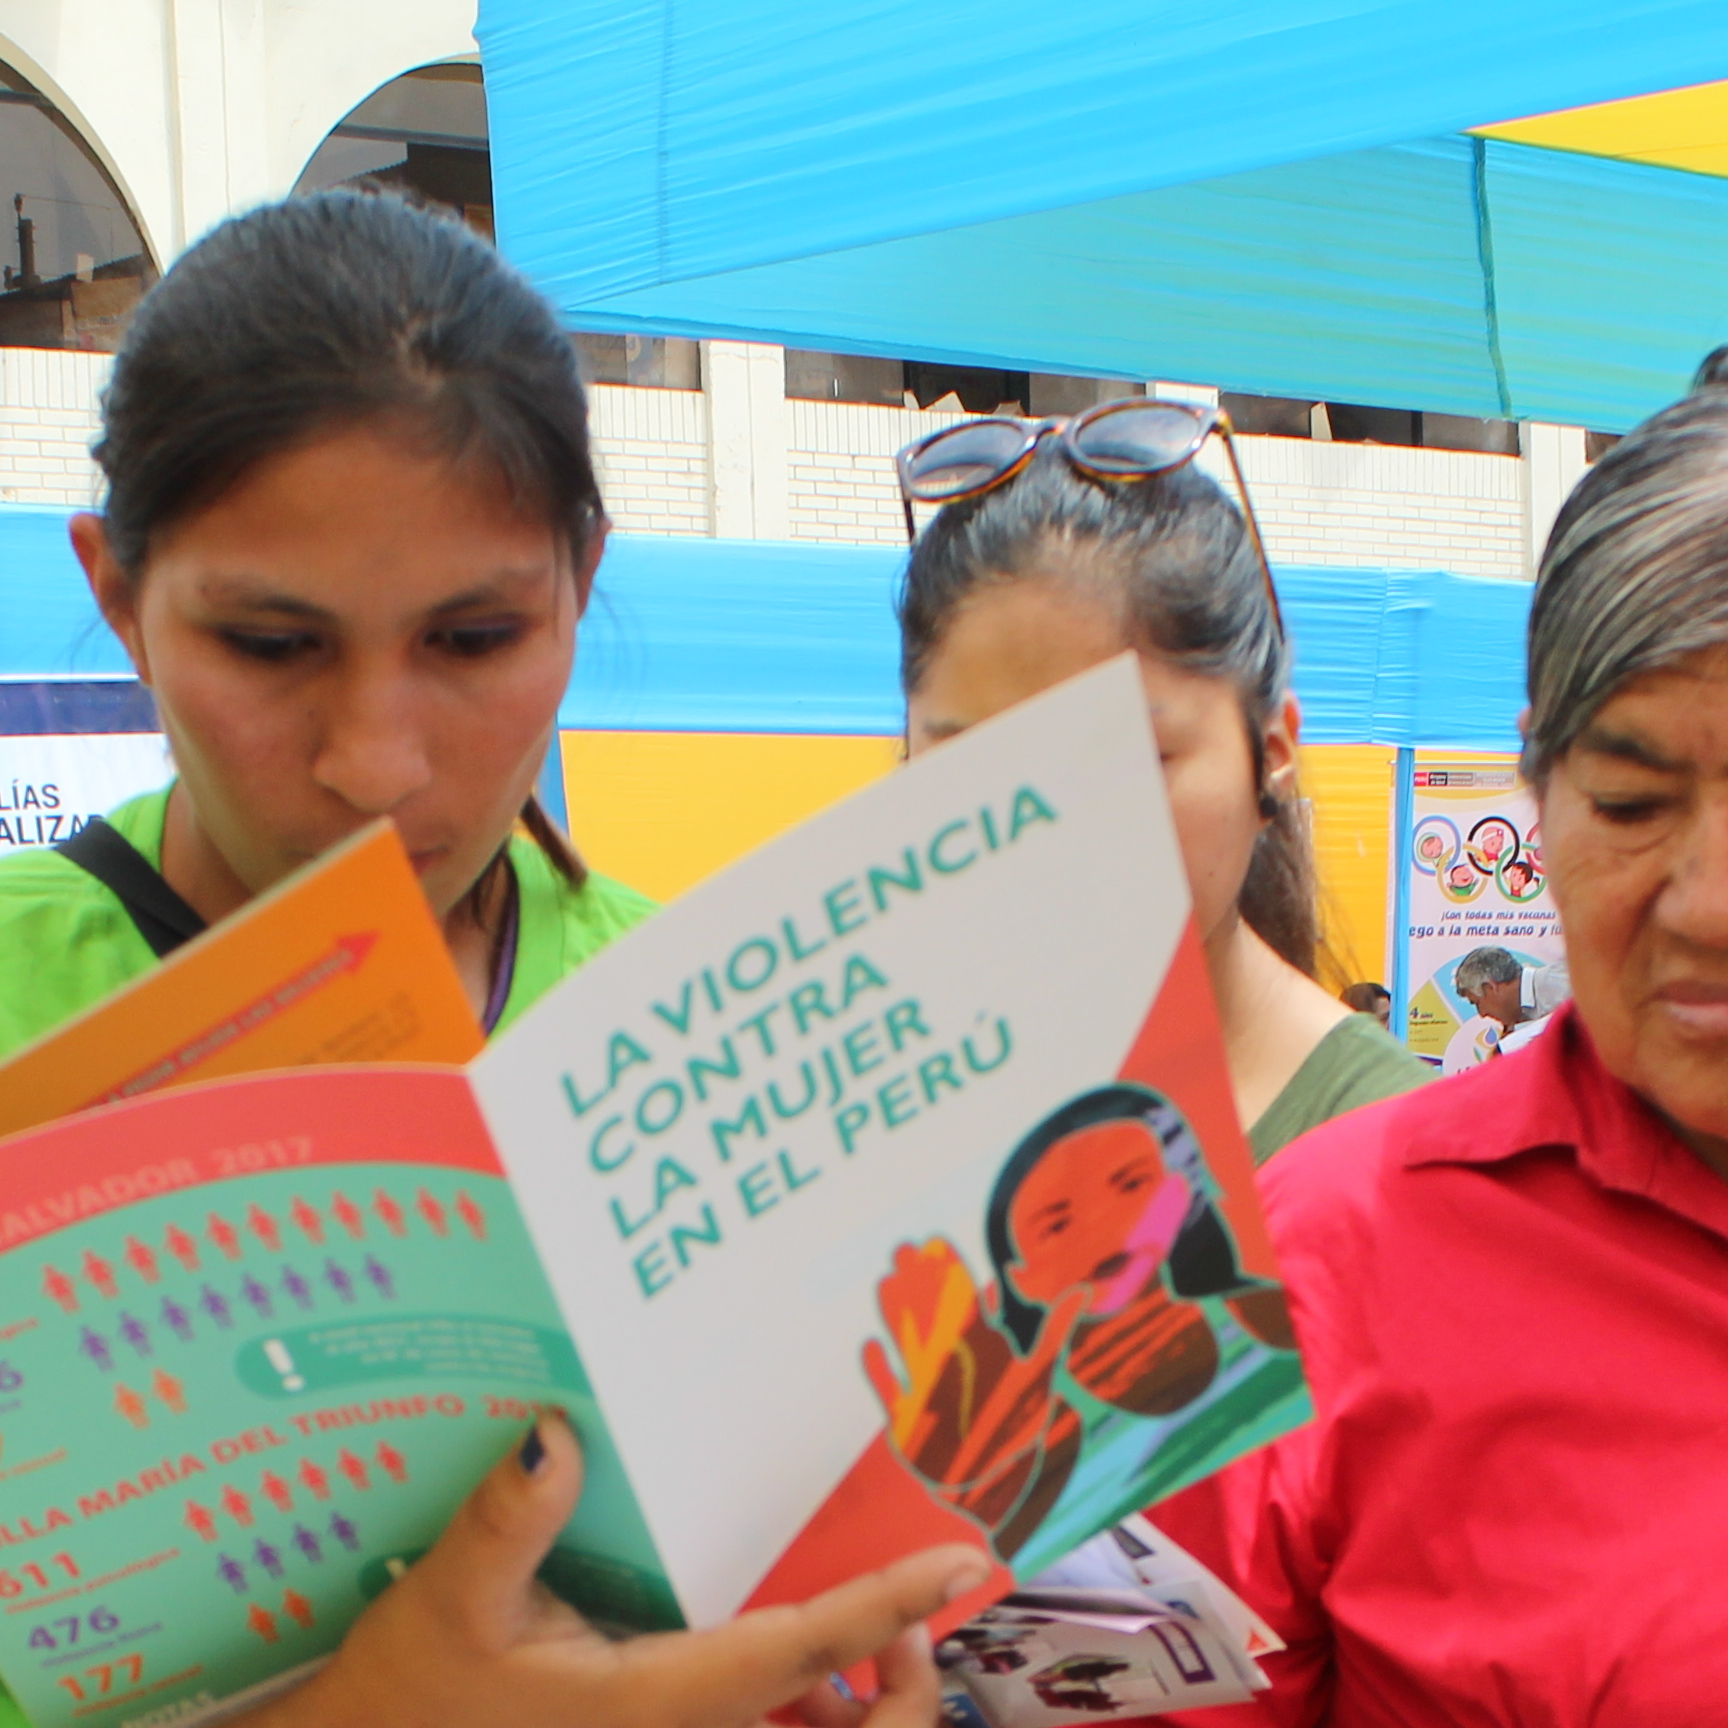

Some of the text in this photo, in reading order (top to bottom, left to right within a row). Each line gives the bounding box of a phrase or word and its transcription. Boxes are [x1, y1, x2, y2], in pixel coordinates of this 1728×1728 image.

[559, 783, 1060, 1119] LA VIOLENCIA
[1437, 926, 1445, 937] a
[1449, 924, 1462, 937] la
[1466, 924, 1500, 937] meta
[1503, 925, 1534, 937] sano
[1537, 926, 1548, 938] y
[1465, 910, 1493, 921] todas
[1496, 910, 1515, 921] mis
[588, 951, 890, 1173] CONTRA
[210, 1135, 313, 1180] 2017
[609, 997, 932, 1240] LA MUJER
[631, 1008, 1013, 1300] EN EL PERÚ
[76, 1452, 208, 1518] MARÍA
[209, 1424, 289, 1466] DEL
[288, 1392, 467, 1437] TRIUNFO
[29, 1605, 121, 1650] 476
[57, 1653, 144, 1702] 177
